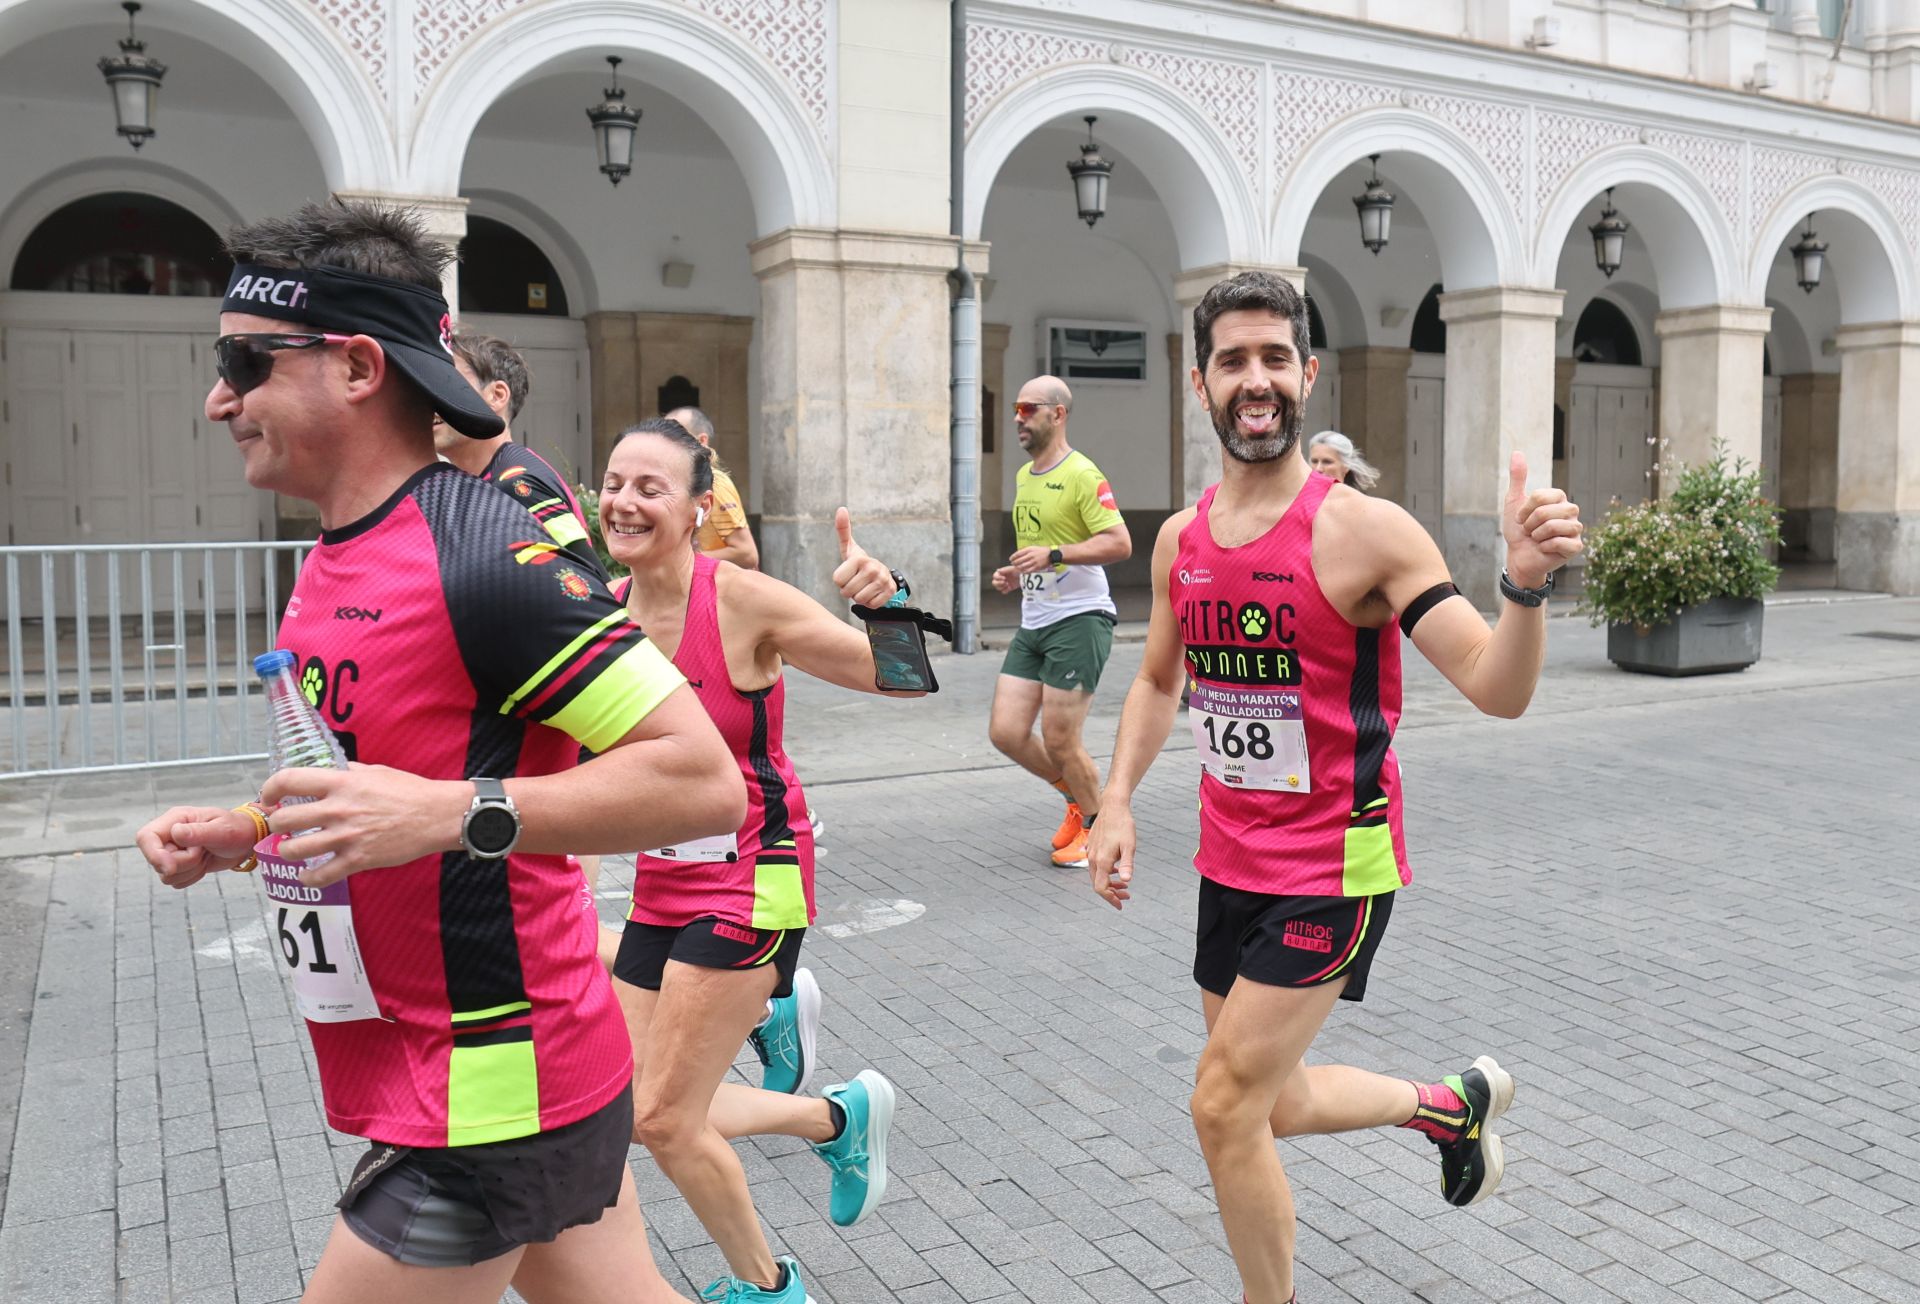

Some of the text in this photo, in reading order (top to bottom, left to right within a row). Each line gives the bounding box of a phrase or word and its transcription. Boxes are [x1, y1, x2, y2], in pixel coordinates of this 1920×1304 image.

[1016, 505, 1041, 533] ES
[1208, 689, 1238, 704] MEDIA
[1203, 700, 1283, 718] DE VALLADOLID
[1203, 716, 1275, 761] 168
[1224, 763, 1246, 772] JAIME
[1285, 920, 1334, 940] HITROC
[277, 907, 338, 974] 61
[1286, 935, 1329, 951] RUNNER
